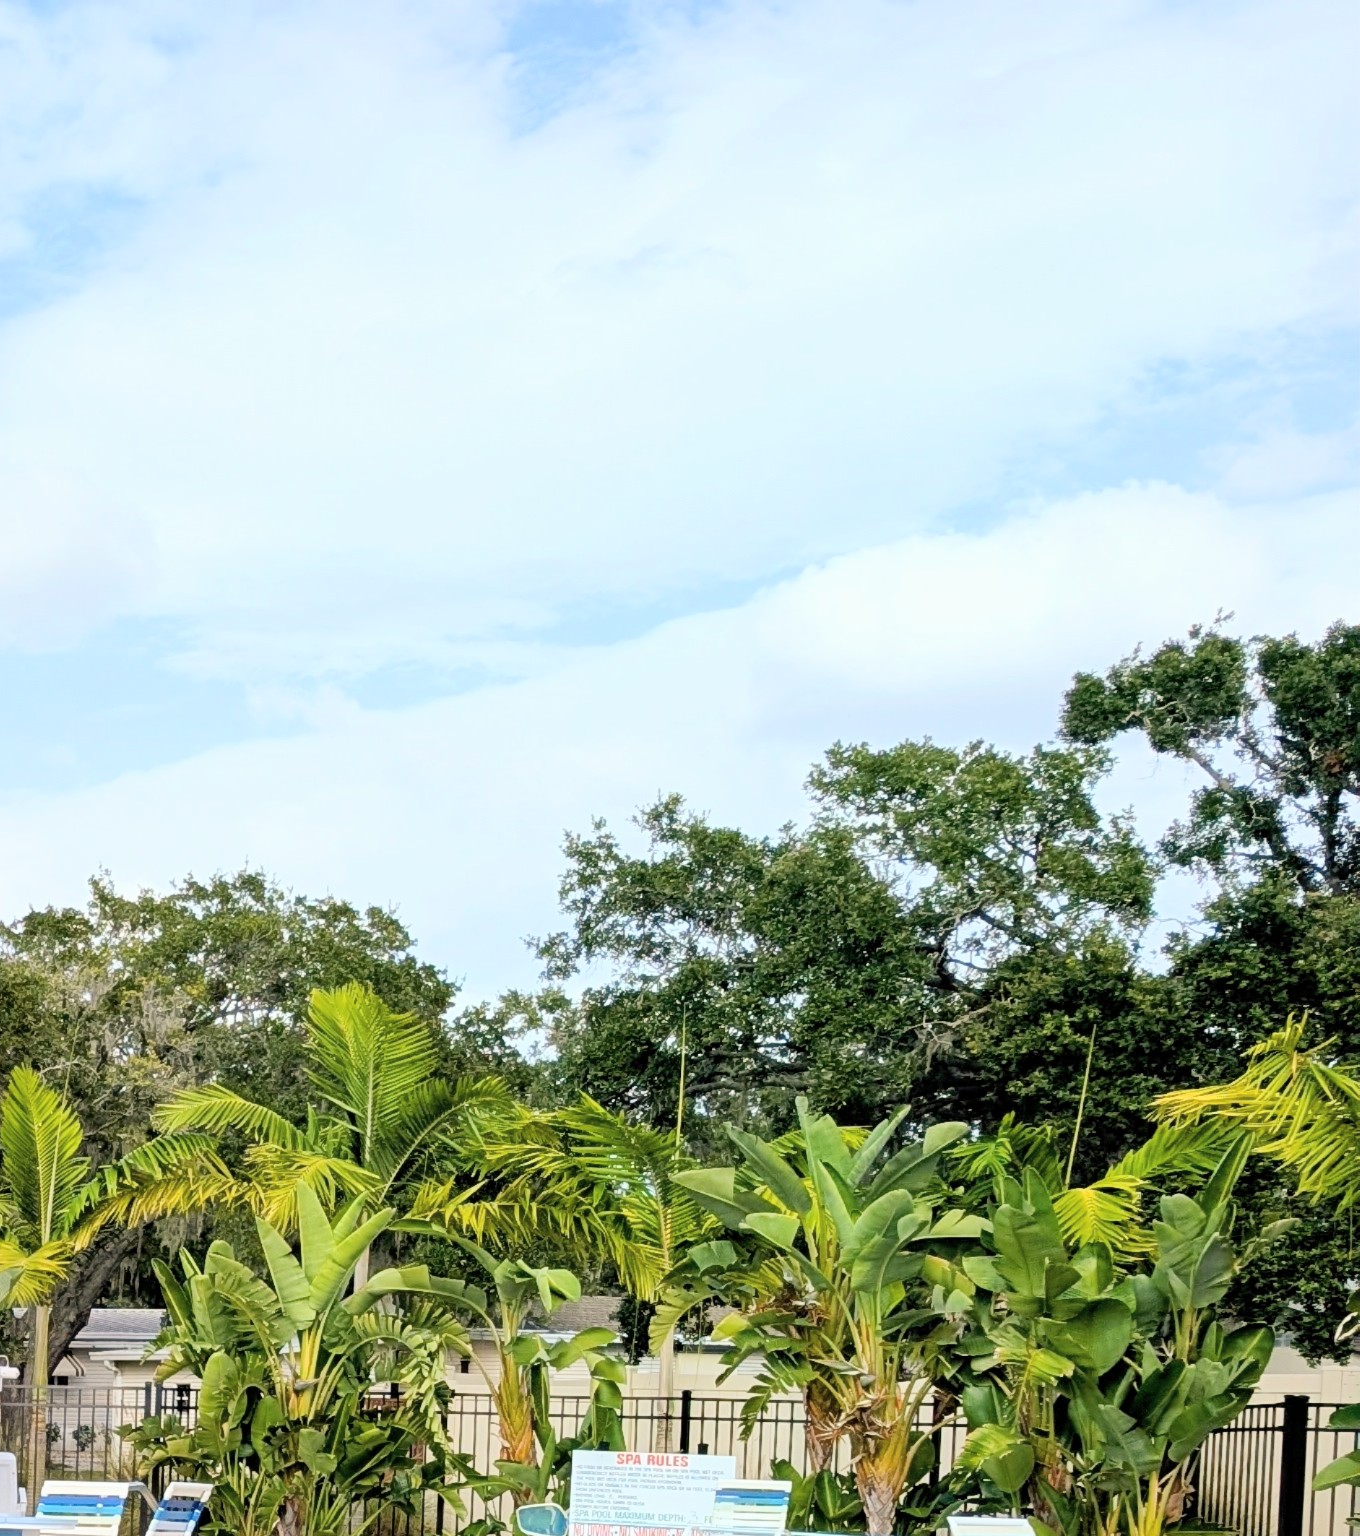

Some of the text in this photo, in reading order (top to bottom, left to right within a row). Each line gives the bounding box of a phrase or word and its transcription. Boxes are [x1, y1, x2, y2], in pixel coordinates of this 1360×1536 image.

[616, 1453, 689, 1467] SPA RULES
[574, 1509, 589, 1517] SPA
[591, 1510, 612, 1519] POOL
[574, 1523, 585, 1536] NO
